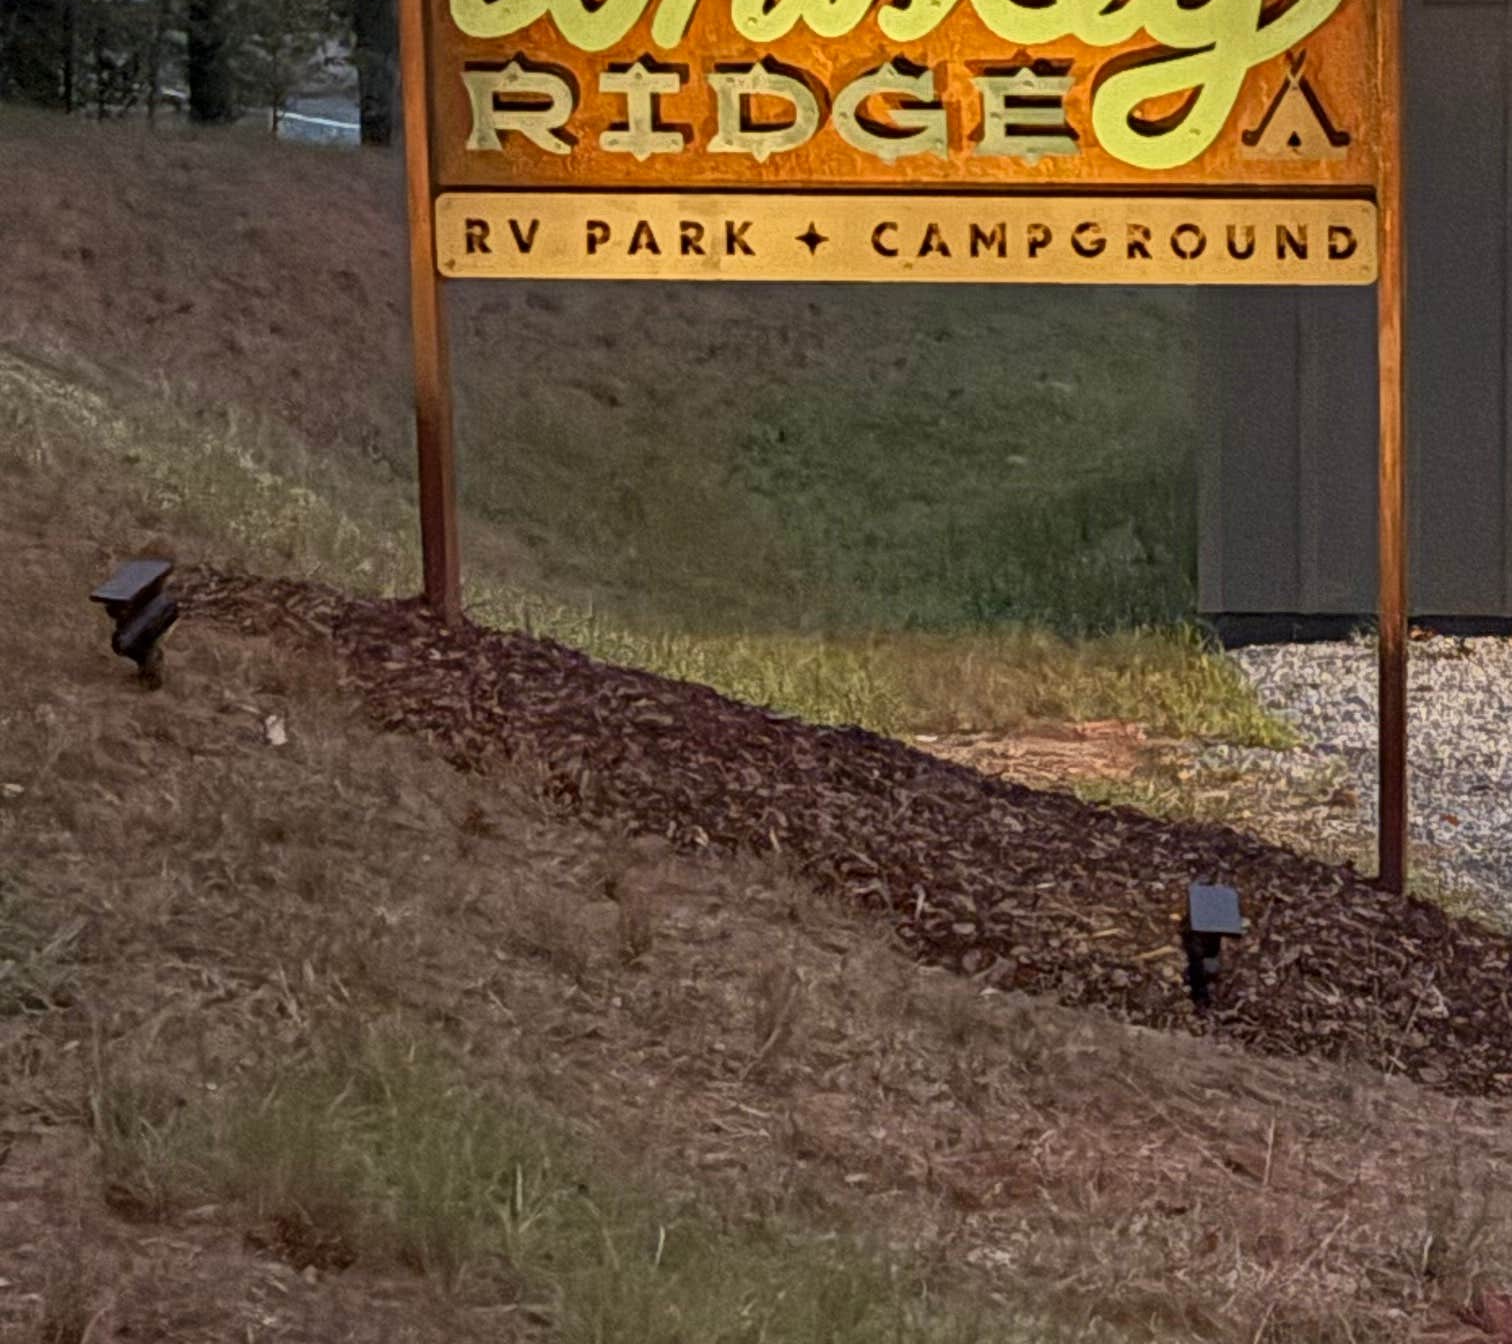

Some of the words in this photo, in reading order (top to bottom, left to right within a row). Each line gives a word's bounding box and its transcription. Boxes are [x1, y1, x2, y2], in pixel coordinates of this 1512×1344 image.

[462, 60, 1081, 163] RIDGE
[464, 218, 541, 255] RV
[586, 220, 757, 257] PARK
[871, 222, 1358, 259] CAMPGROUND
